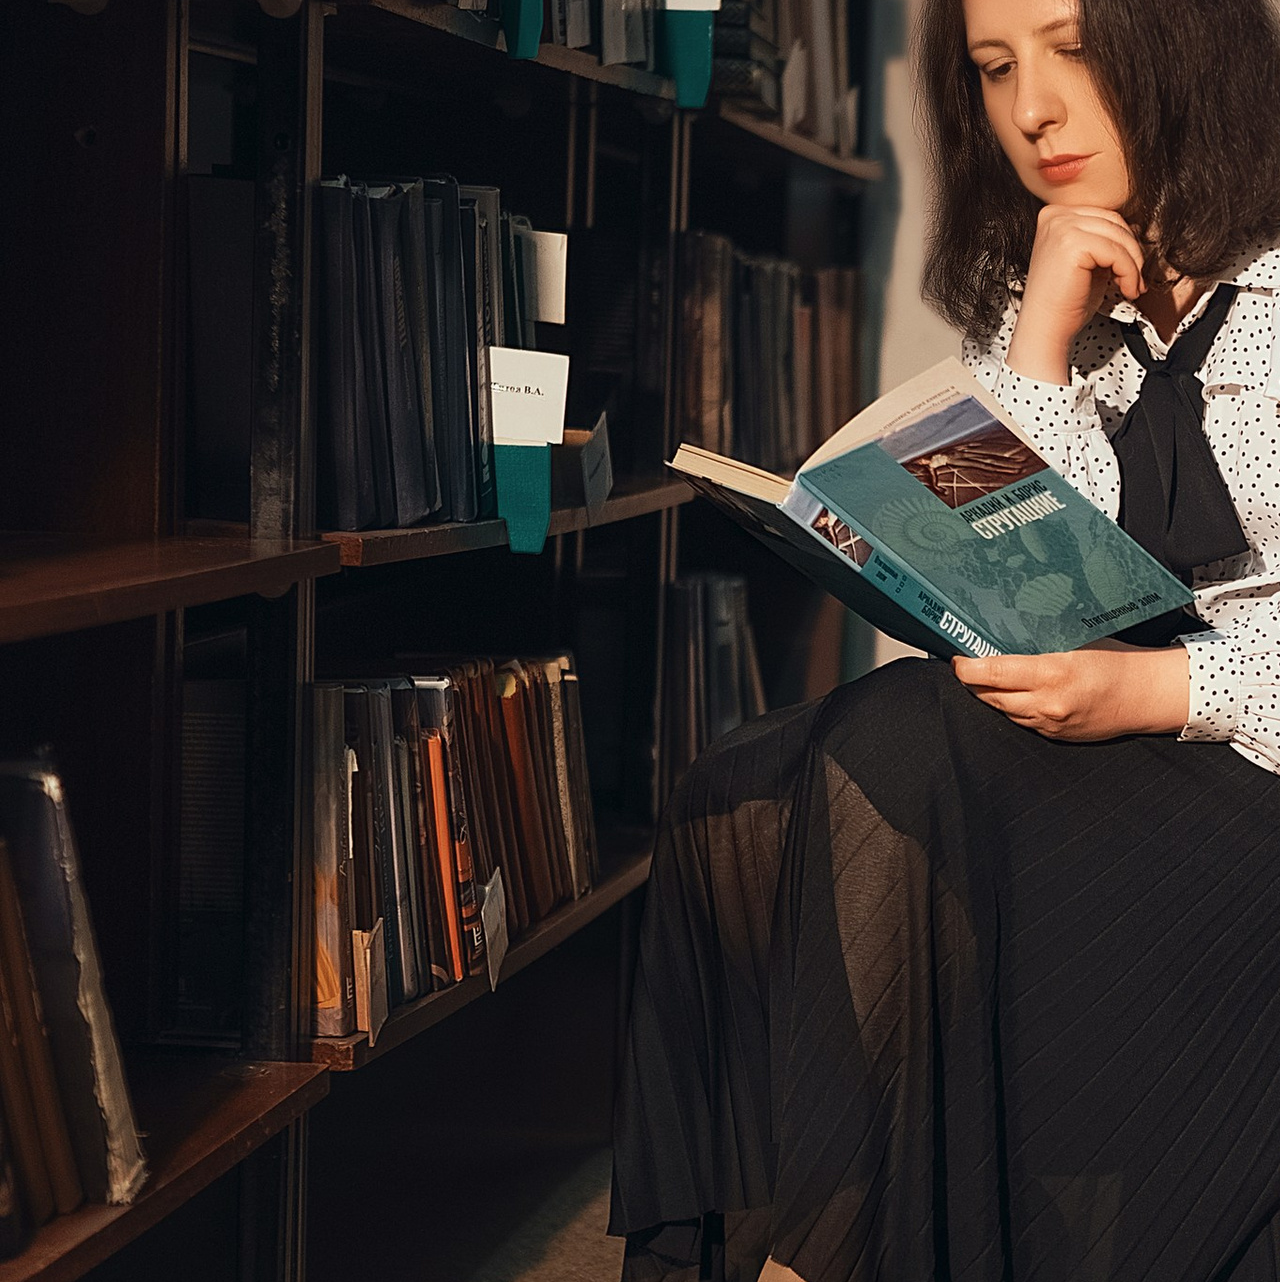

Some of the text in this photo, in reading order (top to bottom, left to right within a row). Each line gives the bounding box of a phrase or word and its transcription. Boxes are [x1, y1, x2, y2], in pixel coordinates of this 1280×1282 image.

[523, 385, 544, 397] В.А.
[959, 479, 1049, 524] АРКАДИЙ И БОРИС
[970, 490, 1067, 540] СТРУГАЦКИЕ
[917, 590, 945, 616] АРКАДИЙ
[920, 605, 943, 625] БОРИС
[1081, 592, 1163, 629] Отягощенные злом
